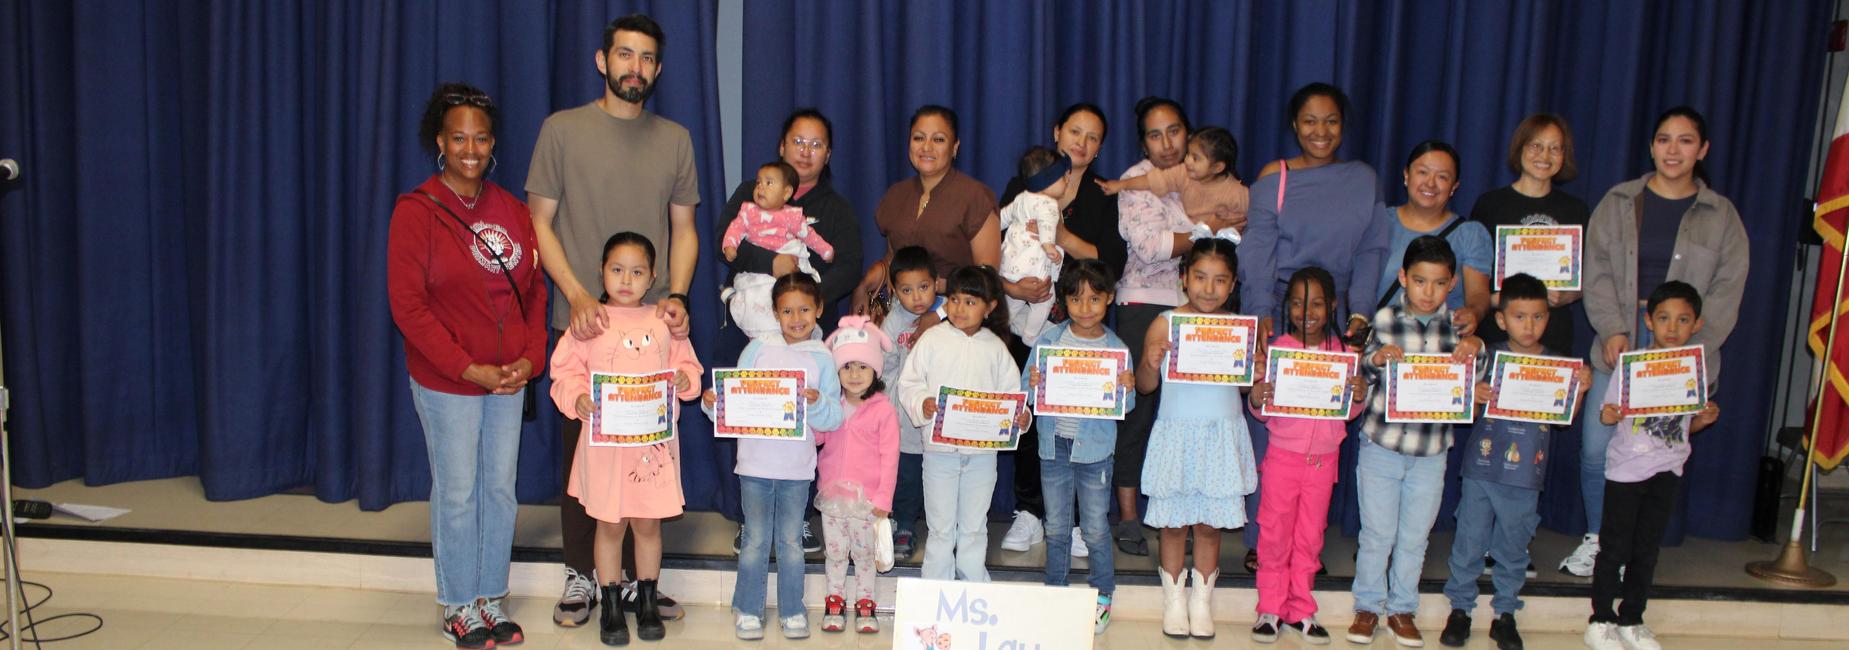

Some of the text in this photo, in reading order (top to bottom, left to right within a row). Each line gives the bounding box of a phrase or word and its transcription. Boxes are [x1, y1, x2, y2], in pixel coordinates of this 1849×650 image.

[1185, 334, 1242, 343] ATTENDANCE
[1053, 366, 1110, 376] ATTENDANCE
[1283, 368, 1340, 379] ATTENDANCE
[1403, 372, 1458, 380] ATTENDANCE
[1636, 366, 1690, 378] ATTENDANCE
[1508, 372, 1564, 383] ATTENDANCE
[730, 387, 790, 395] ATTENDANCE
[608, 391, 662, 402] ATTENDANCE
[952, 404, 1009, 414] ATTENDANCE
[936, 588, 998, 626] Ms.
